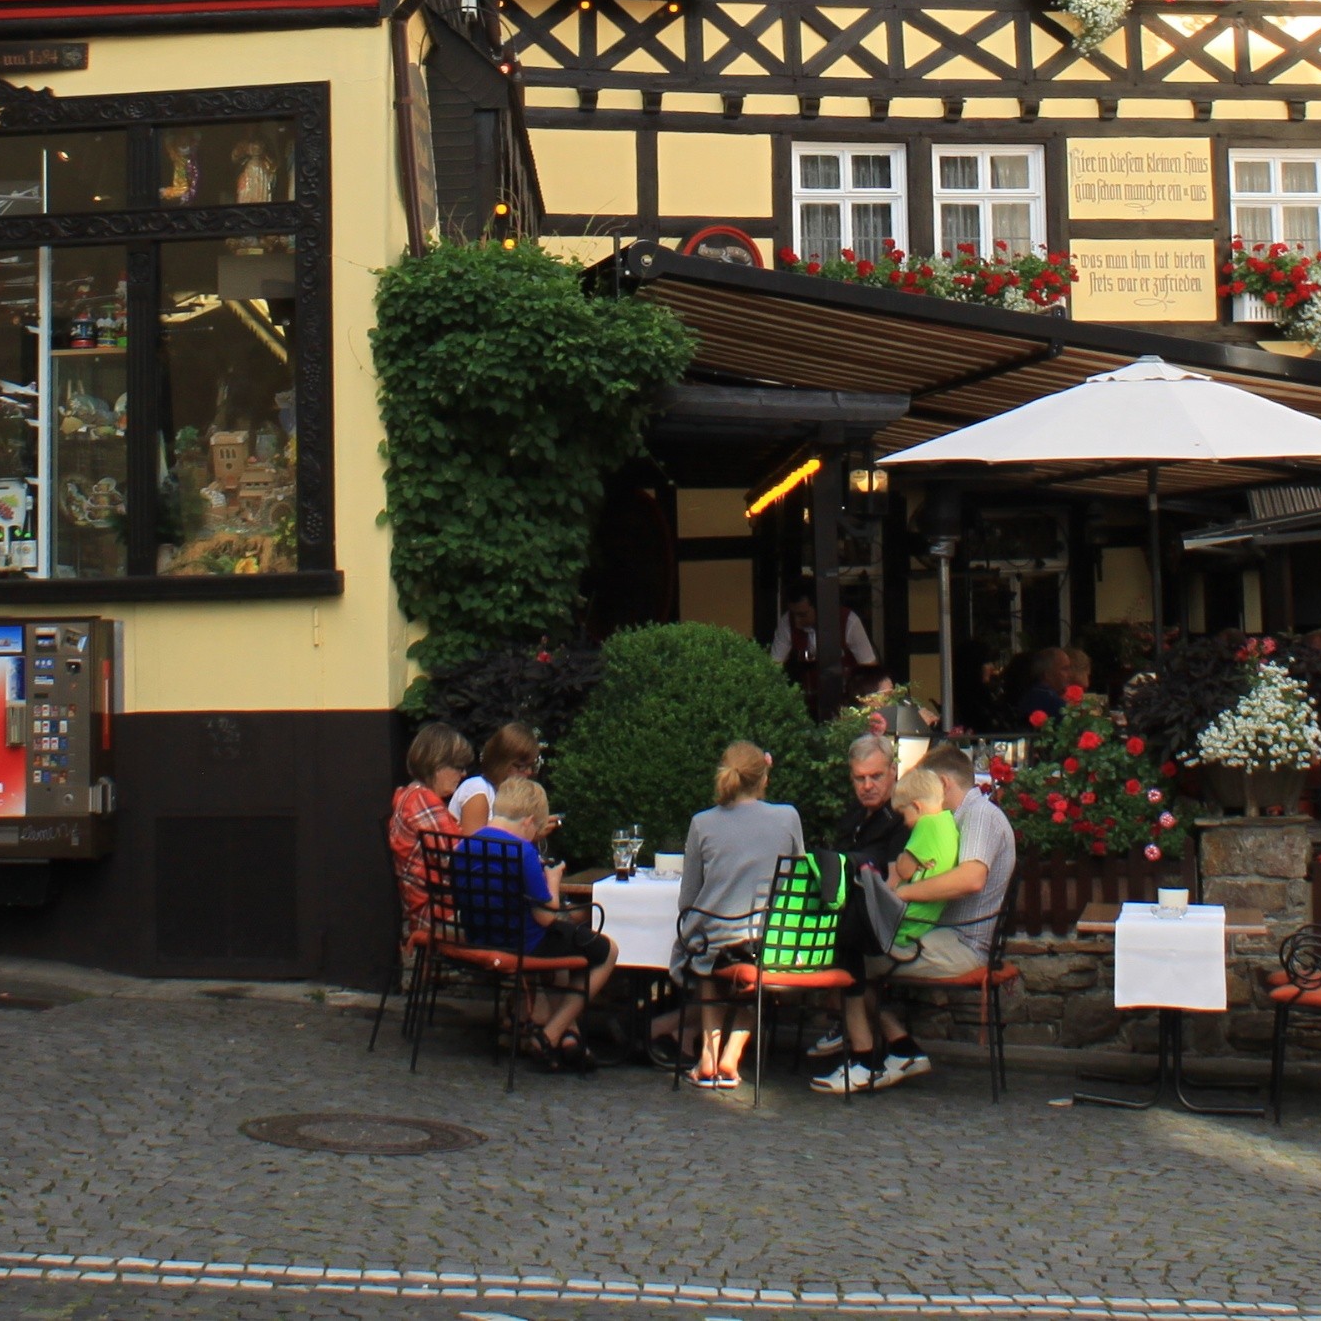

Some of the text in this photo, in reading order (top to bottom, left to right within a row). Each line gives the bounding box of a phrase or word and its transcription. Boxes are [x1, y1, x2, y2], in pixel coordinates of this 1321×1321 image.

[1097, 152, 1109, 173] in
[1146, 152, 1182, 174] kleinen
[1074, 182, 1097, 203] ging
[1124, 180, 1167, 205] mancher
[1167, 181, 1183, 202] ein
[1190, 184, 1208, 202] aus
[1080, 254, 1104, 270] was
[1105, 254, 1129, 270] man
[1130, 250, 1152, 273] ihm
[1173, 251, 1207, 270] bieten
[1116, 277, 1139, 293] war
[1139, 277, 1152, 293] er
[1152, 274, 1203, 298] zufrieden
